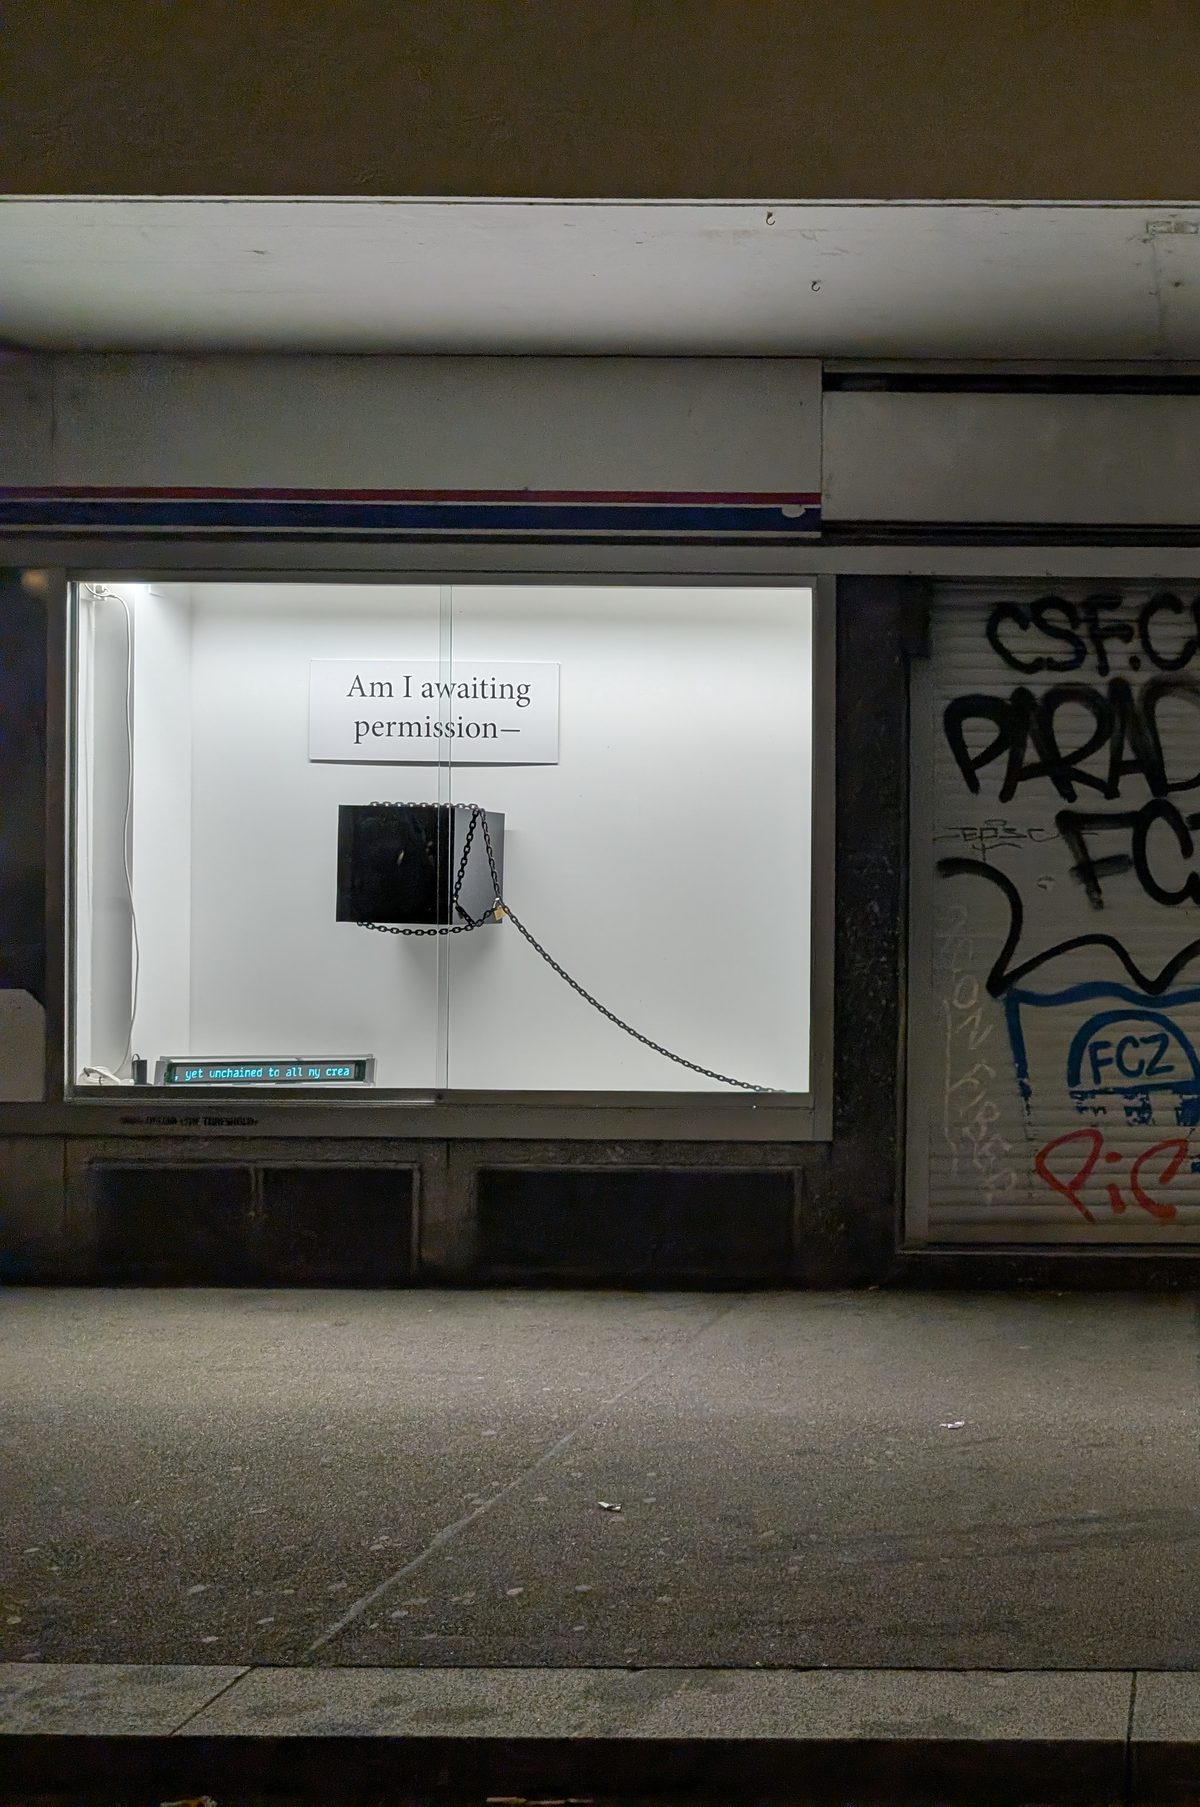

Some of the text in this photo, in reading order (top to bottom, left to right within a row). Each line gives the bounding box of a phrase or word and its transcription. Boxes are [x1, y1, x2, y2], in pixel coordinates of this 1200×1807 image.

[346, 674, 532, 708] Am I awaiting
[185, 1069, 203, 1080] yet
[209, 1068, 263, 1079] unchained
[268, 1067, 280, 1077] to
[285, 1067, 303, 1077] all
[326, 1067, 350, 1076] crea
[1089, 1037, 1175, 1086] FCZ
